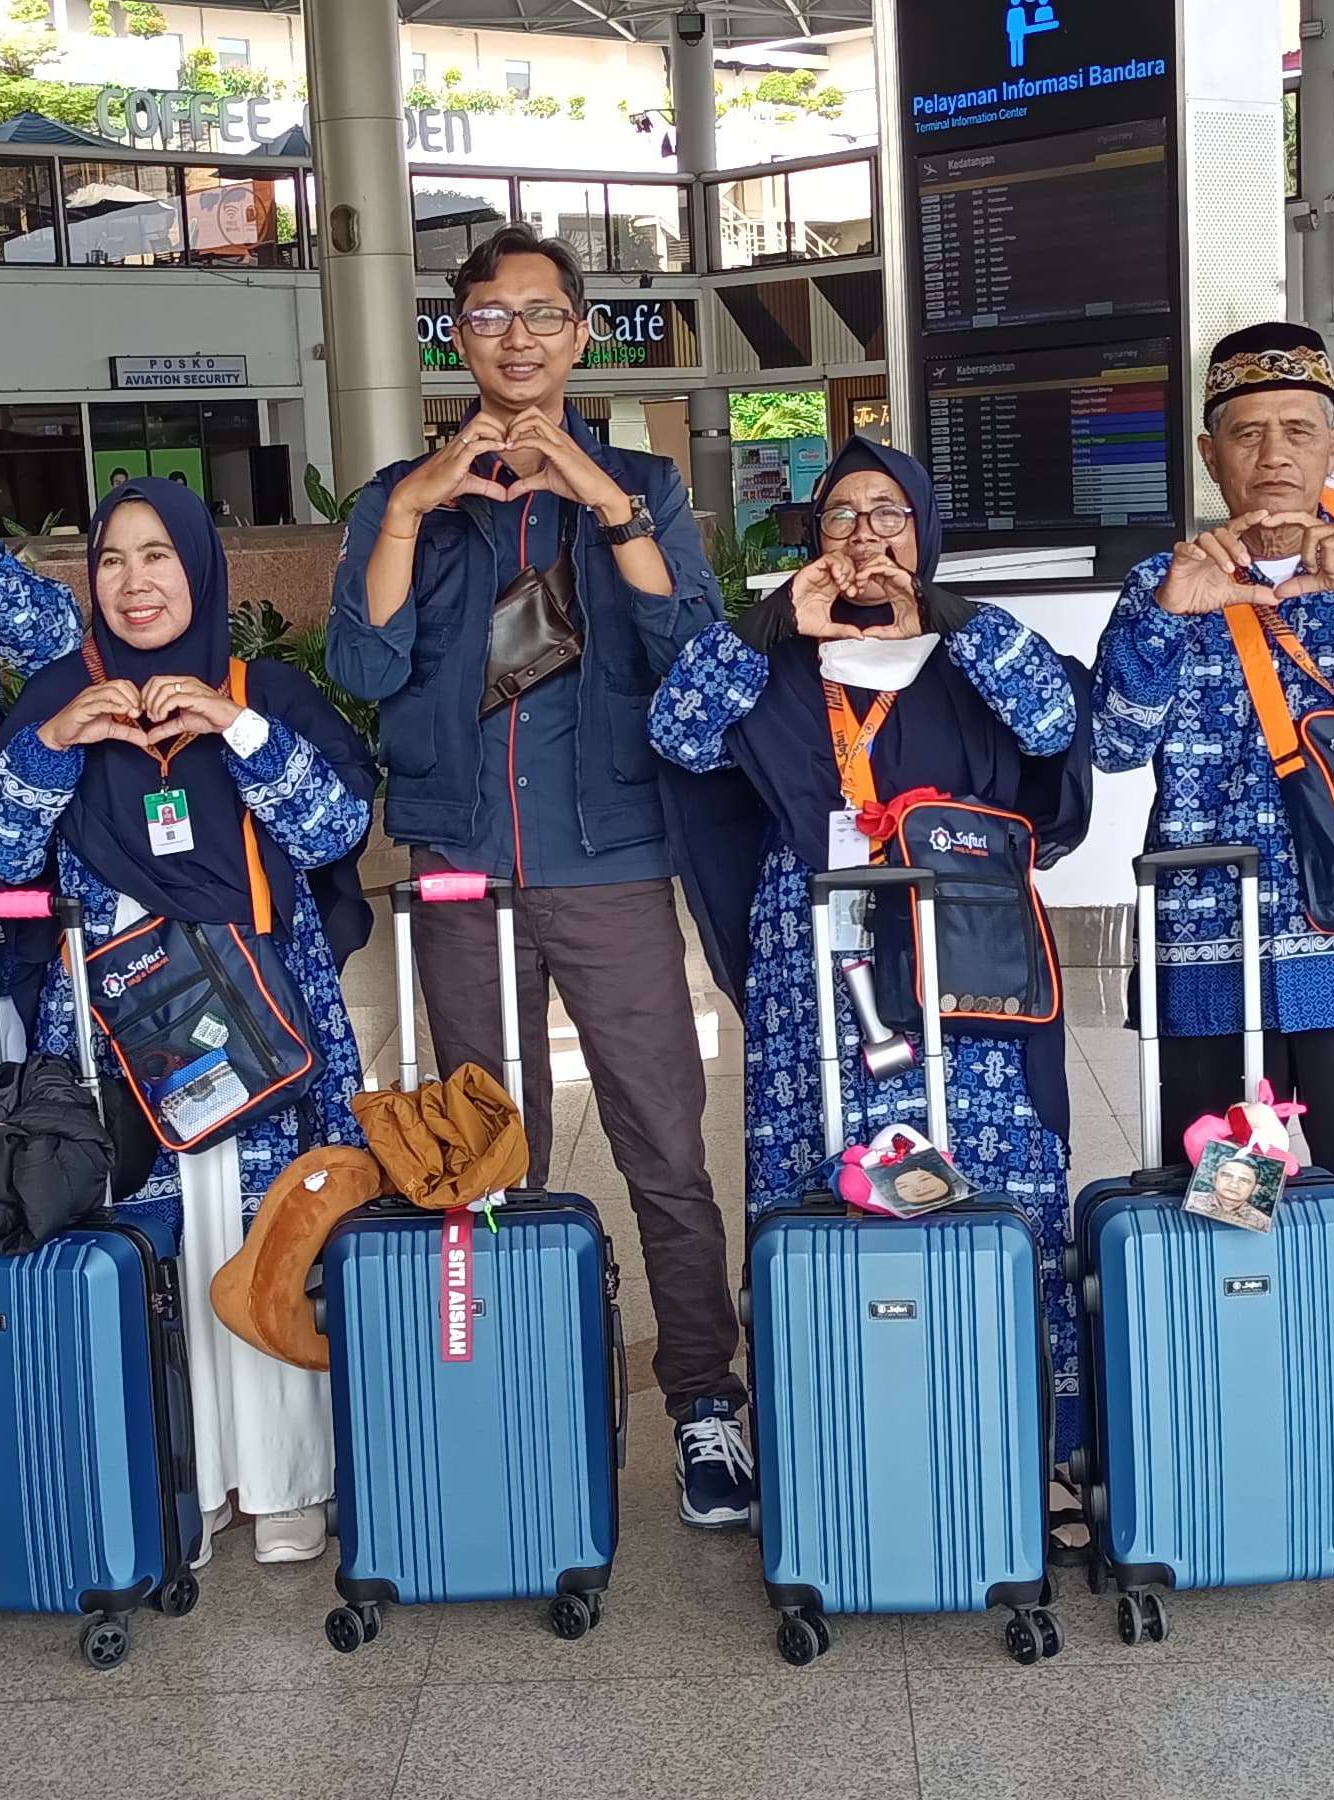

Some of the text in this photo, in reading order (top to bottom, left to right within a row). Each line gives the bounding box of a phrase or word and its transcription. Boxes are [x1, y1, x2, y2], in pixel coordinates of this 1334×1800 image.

[913, 58, 1166, 116] Pelayanan Informasi Bandara
[95, 88, 274, 144] COFFEE
[915, 106, 1028, 133] Terminal Information Center
[947, 154, 996, 170] Kedatangan
[586, 303, 665, 342] Café
[578, 346, 646, 368] ejak1999
[125, 373, 240, 385] AVIATION SECURITY
[950, 831, 988, 850] Safari
[123, 945, 166, 979] Safari
[448, 1249, 467, 1355] SITI AISIAH
